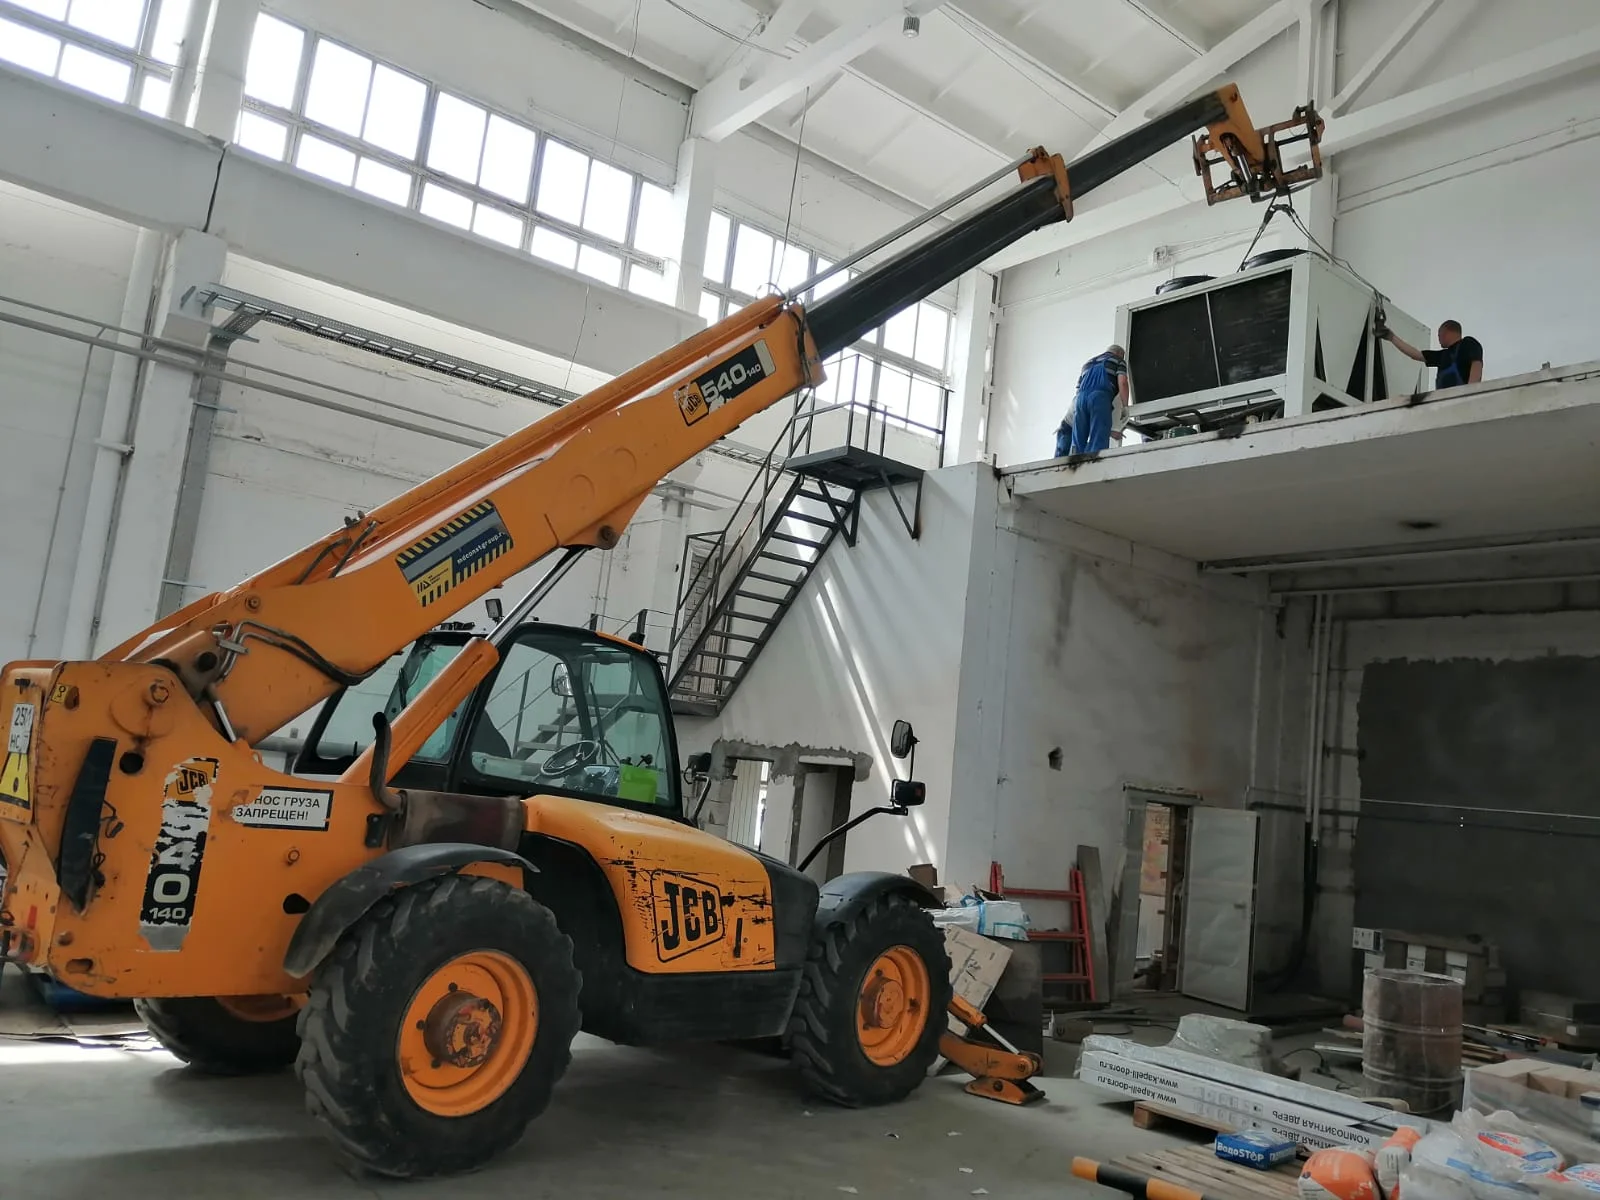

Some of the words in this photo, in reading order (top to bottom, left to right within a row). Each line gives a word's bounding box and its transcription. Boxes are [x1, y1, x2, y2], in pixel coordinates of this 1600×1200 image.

[686, 393, 702, 414] JCB
[701, 363, 747, 403] 540
[746, 363, 762, 377] 140
[179, 769, 207, 791] JCB
[254, 795, 281, 806] НОС
[284, 796, 320, 808] ГРУЗА
[236, 807, 309, 821] ЗАПРЕЩЕН!
[149, 907, 187, 920] 140
[661, 881, 718, 951] JCB
[1099, 1060, 1179, 1089] www.kapelli-doors.ru
[1097, 1075, 1177, 1105] www.kapelli-doors.ru
[1272, 1110, 1301, 1125] ДВЕРЬ
[1301, 1119, 1370, 1145] КОМПОЗИТНАЯ
[1217, 1142, 1264, 1162] ВодоSTOP
